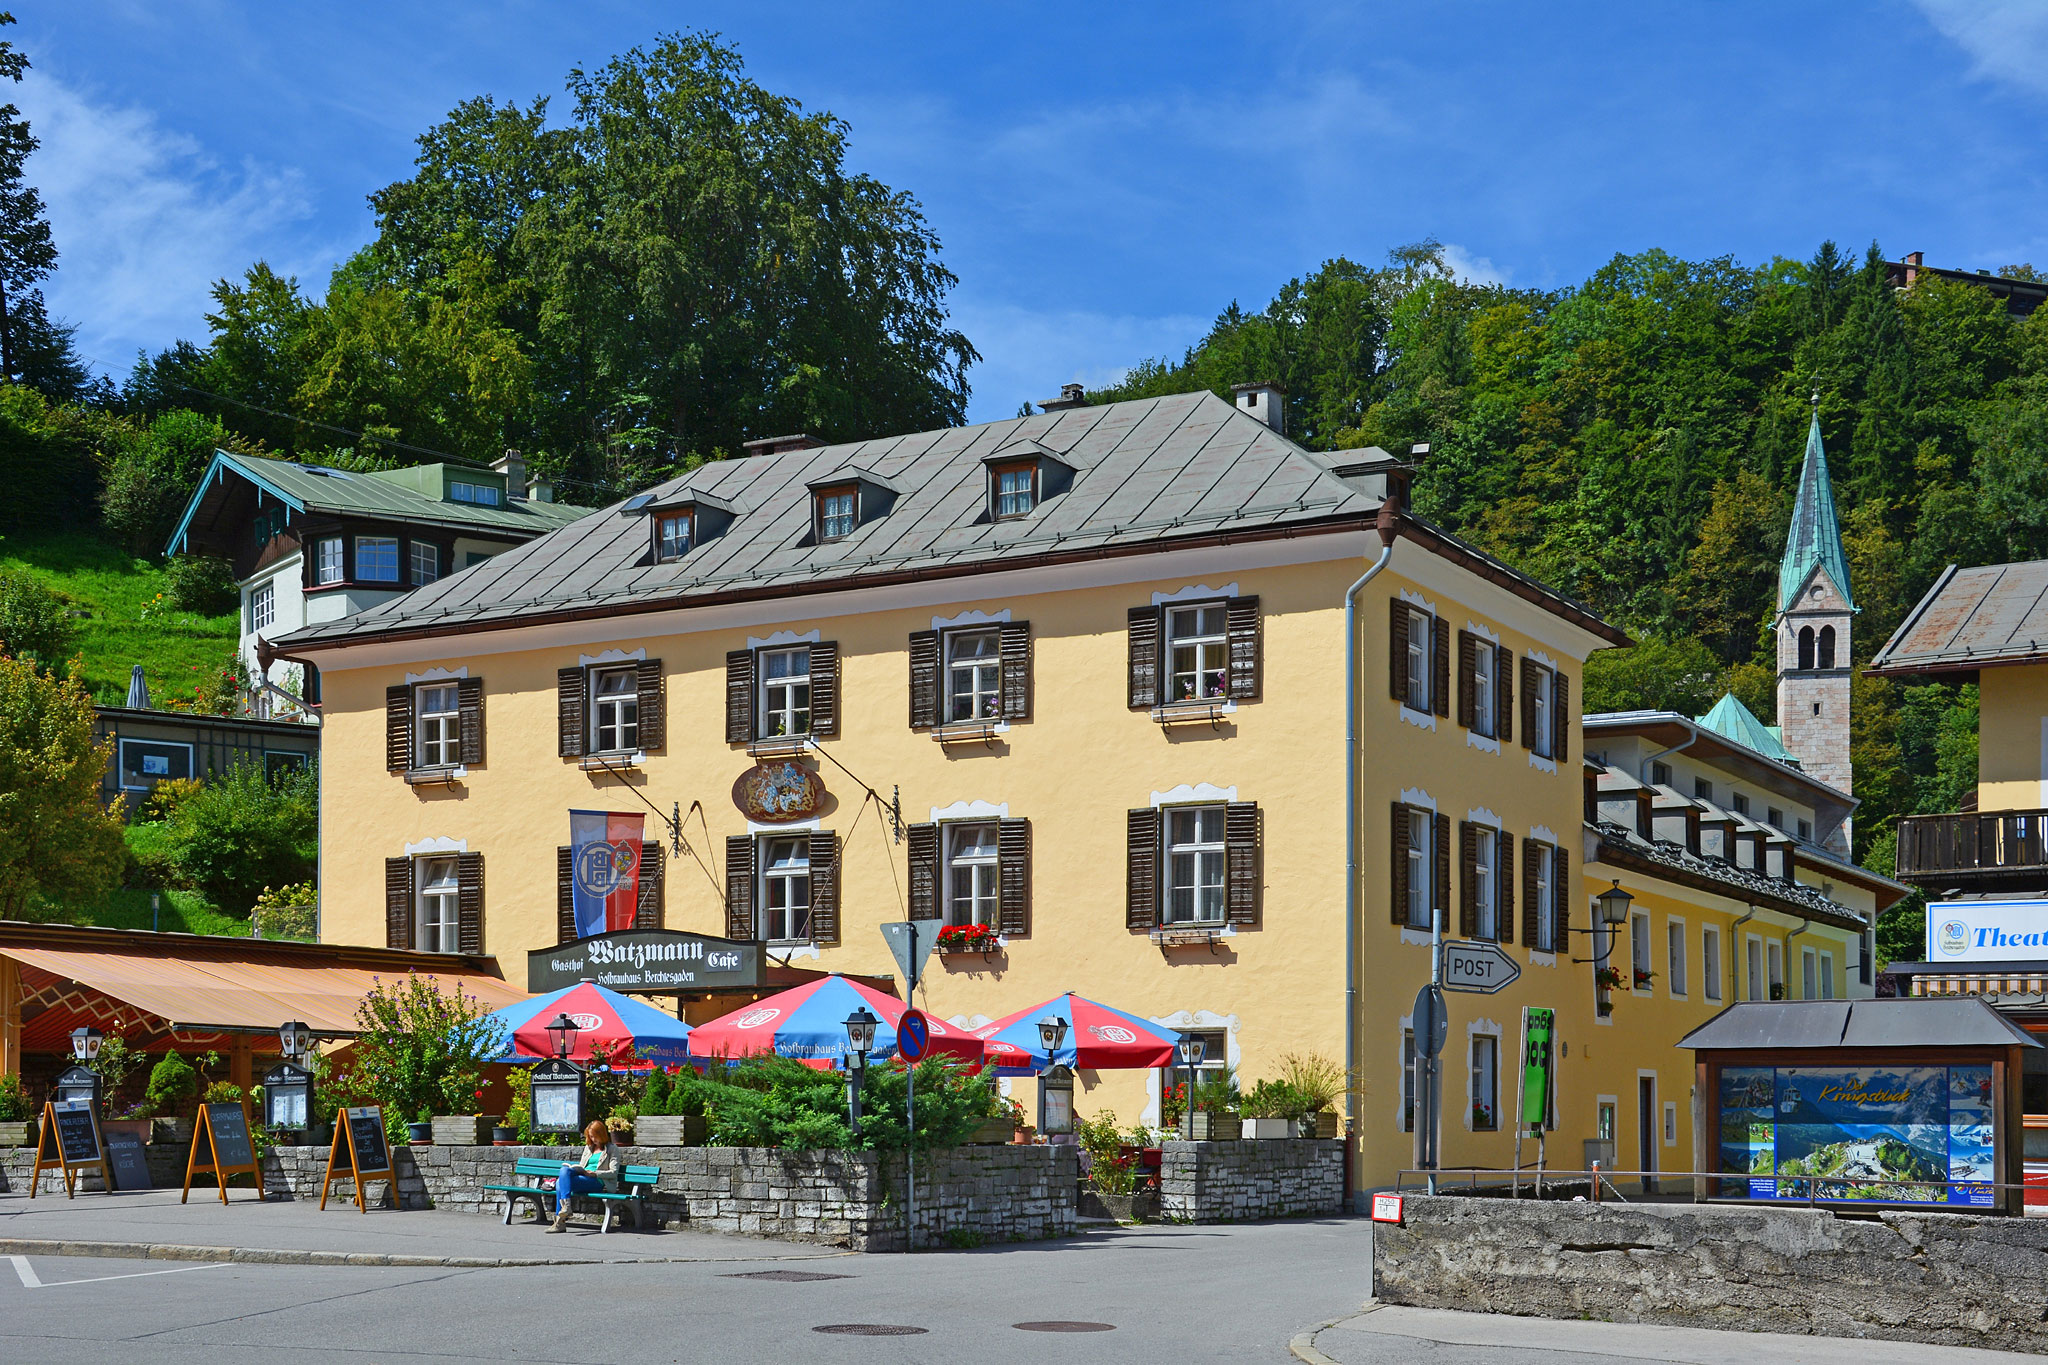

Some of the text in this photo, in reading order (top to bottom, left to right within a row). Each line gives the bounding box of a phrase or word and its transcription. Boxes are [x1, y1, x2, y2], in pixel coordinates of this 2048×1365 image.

[587, 939, 704, 970] Watzmann
[551, 958, 584, 973] Gasthof
[1454, 958, 1494, 978] POST
[644, 969, 695, 984] Berchtesgaden
[1845, 1077, 1868, 1091] Der
